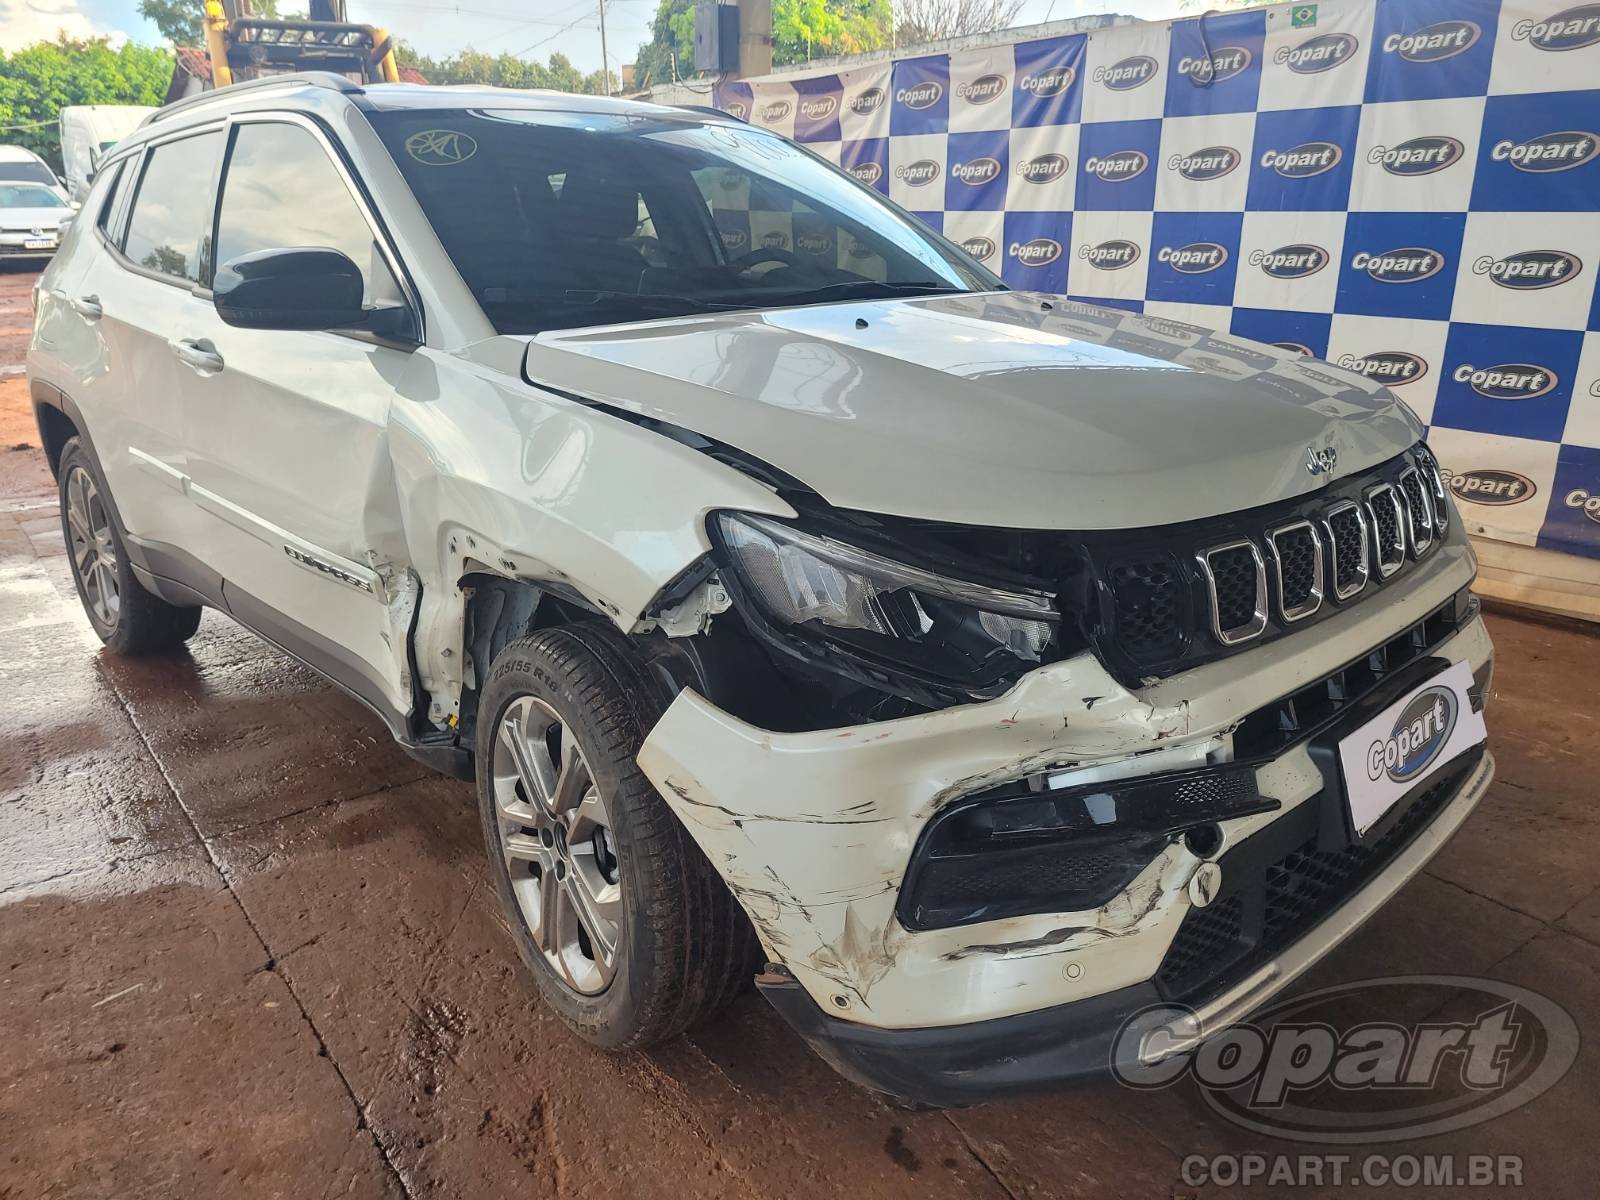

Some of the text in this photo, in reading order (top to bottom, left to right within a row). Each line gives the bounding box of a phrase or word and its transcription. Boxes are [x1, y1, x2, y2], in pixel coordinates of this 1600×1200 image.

[1383, 27, 1470, 53] Copart
[1510, 17, 1600, 42] Copar
[1178, 54, 1240, 78] Copart
[1274, 41, 1345, 67] Copart
[1020, 71, 1071, 94] Copart
[1093, 61, 1149, 86] Copart
[896, 86, 937, 108] Copart
[957, 80, 999, 101] Copart
[801, 98, 834, 119] Copart
[1260, 145, 1332, 170] Copart
[1367, 142, 1453, 169] Copart
[1491, 136, 1591, 165] Copart
[896, 161, 934, 182] Copart
[952, 161, 993, 183] Copart
[1017, 156, 1061, 177] Copart
[1085, 154, 1140, 177] Copart
[1168, 151, 1233, 176] Copart
[1009, 241, 1054, 261] Copart
[1078, 243, 1133, 265] Copart
[1157, 246, 1219, 270] Copart
[1248, 249, 1319, 273] Copart
[1352, 252, 1433, 276] Copart
[1472, 255, 1566, 280] Copart
[1337, 353, 1415, 379] Copart
[1452, 364, 1545, 391] Copart
[1367, 694, 1445, 782] Copart
